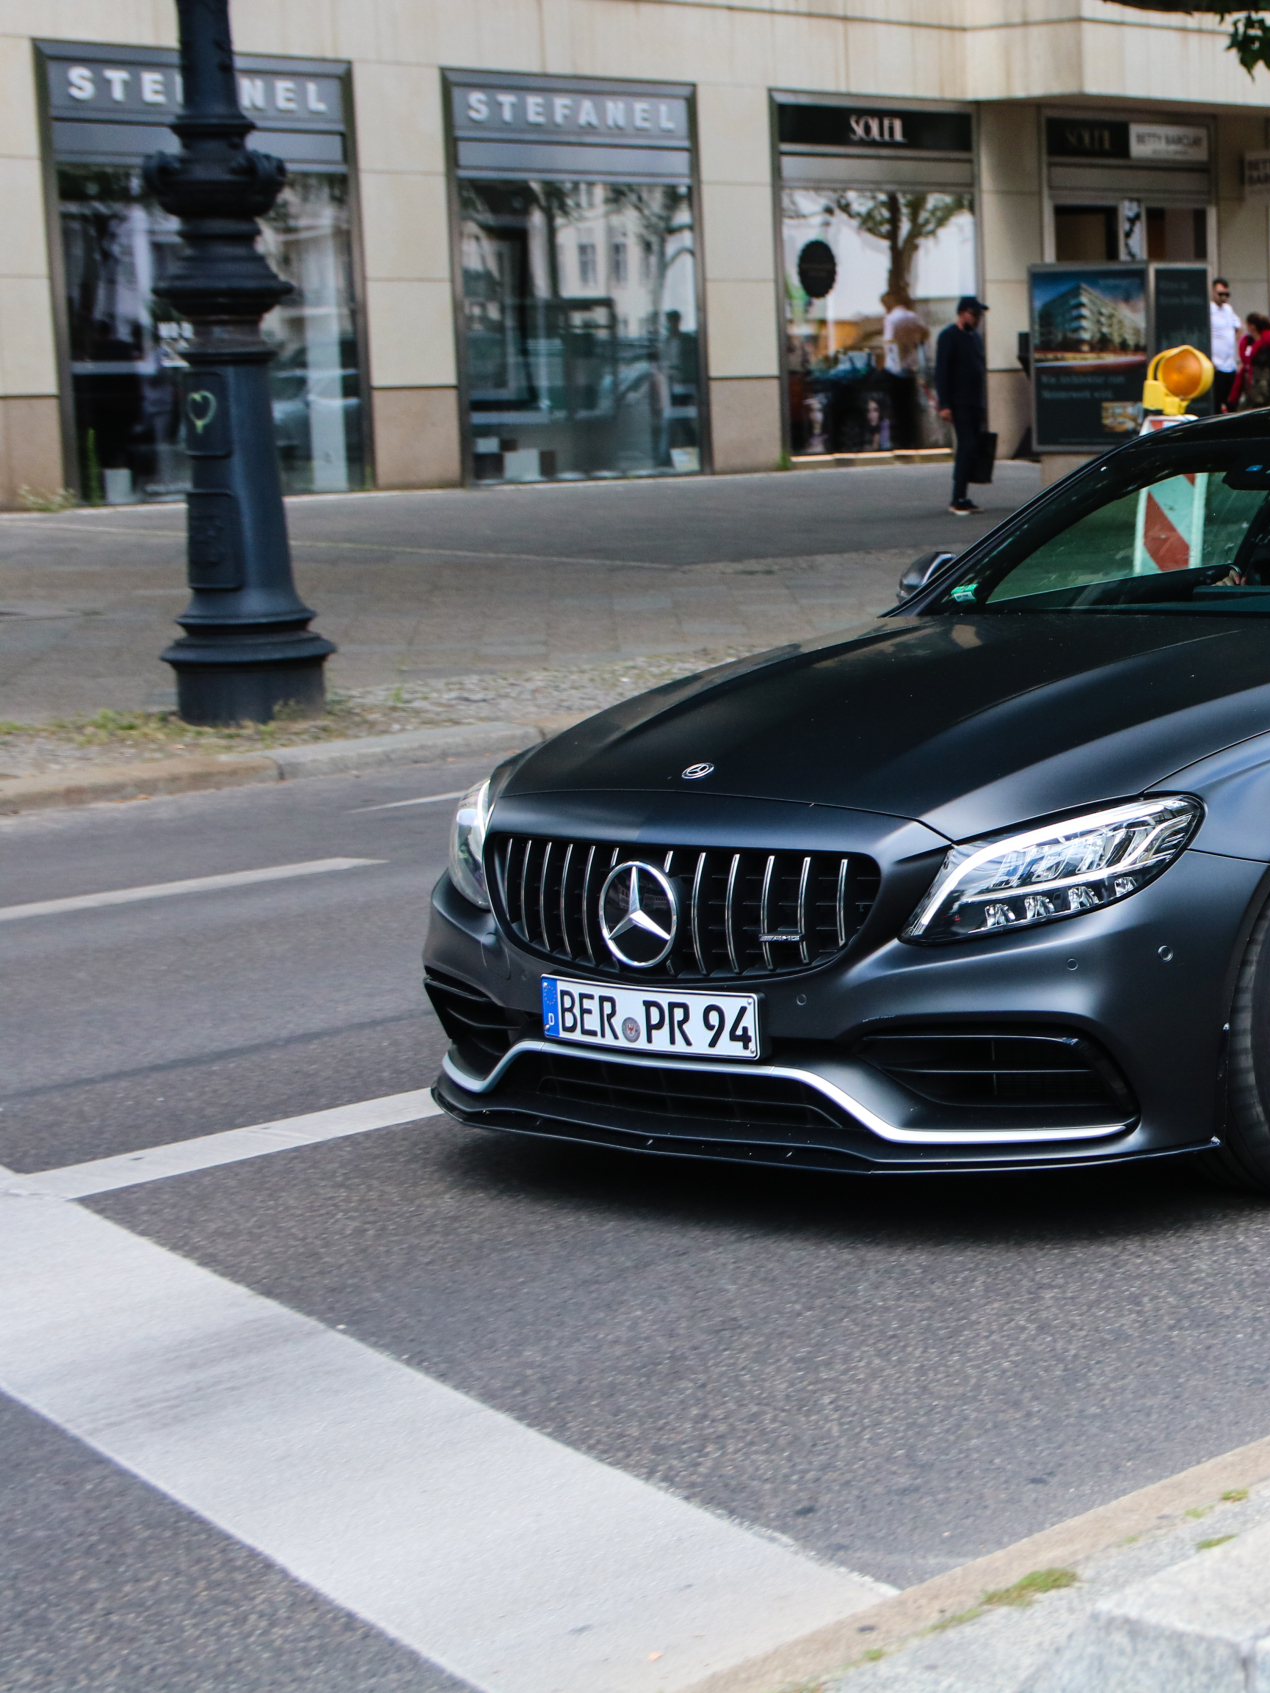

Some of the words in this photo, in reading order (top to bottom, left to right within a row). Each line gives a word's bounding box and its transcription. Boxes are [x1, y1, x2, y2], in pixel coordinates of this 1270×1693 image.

[67, 66, 327, 113] STENEL
[467, 92, 676, 131] STEFANEL
[548, 1012, 555, 1025] D
[559, 989, 620, 1040] BER
[642, 999, 693, 1047] PR
[702, 1003, 752, 1050] 94
